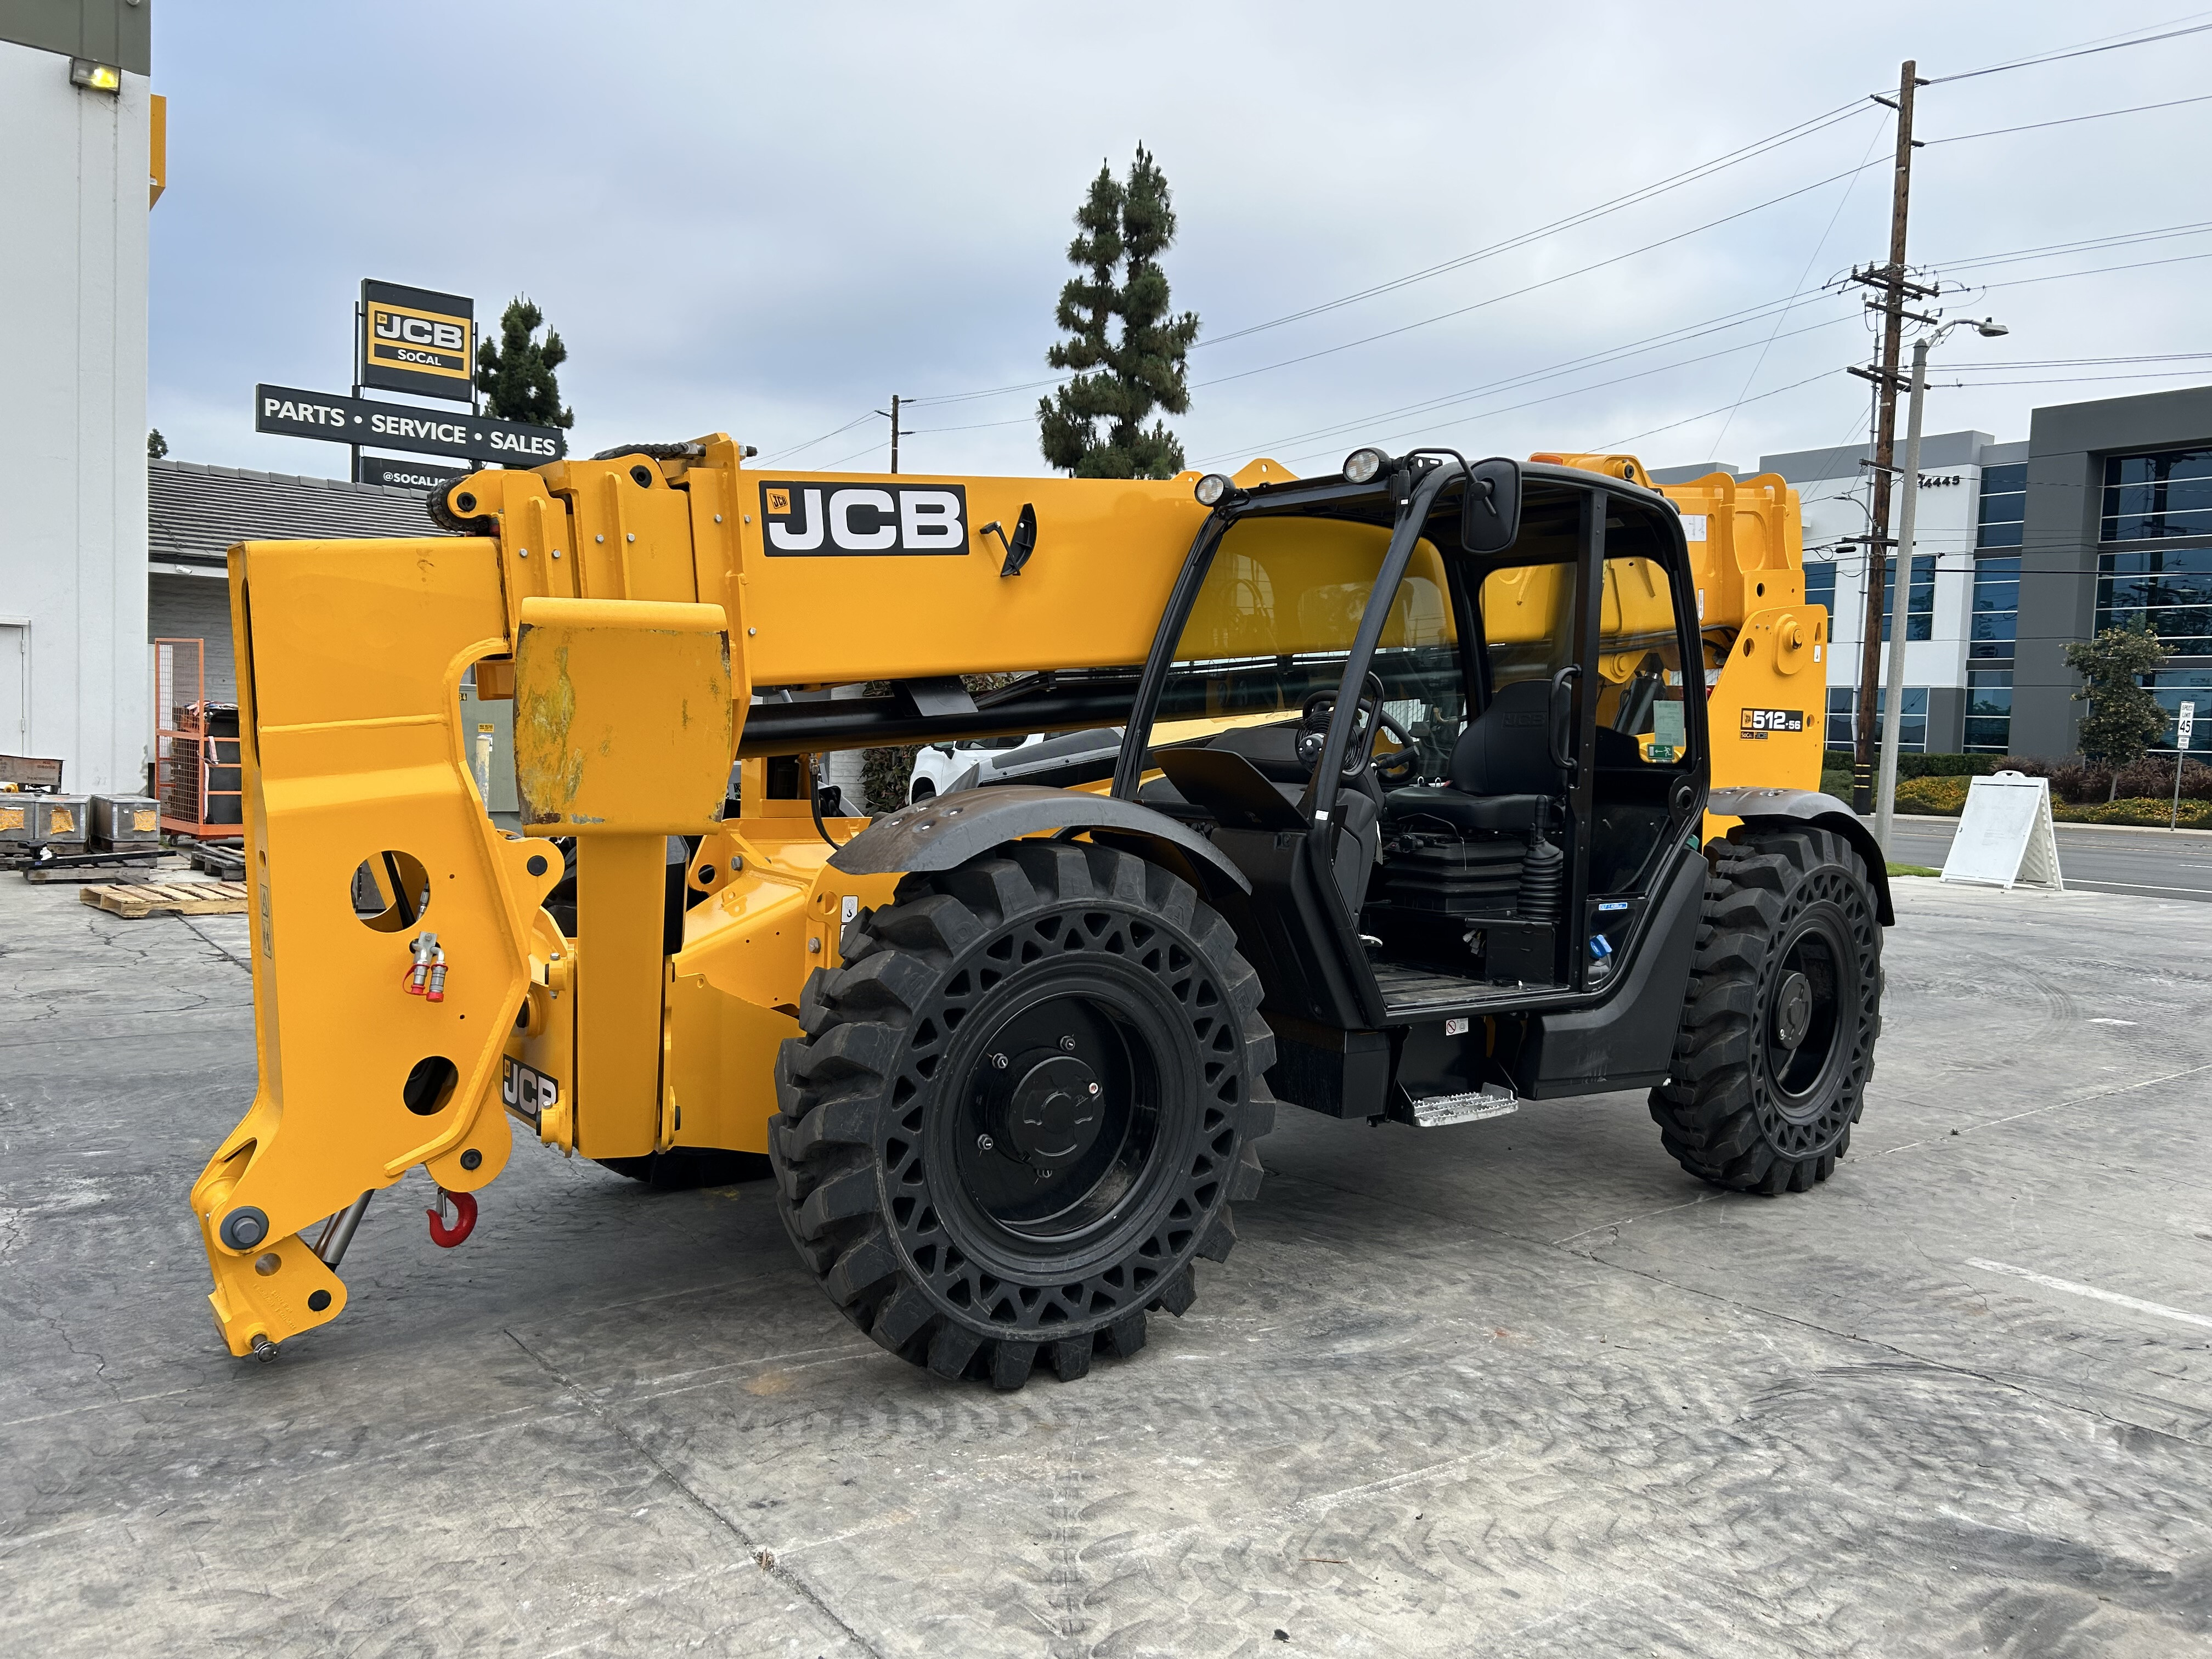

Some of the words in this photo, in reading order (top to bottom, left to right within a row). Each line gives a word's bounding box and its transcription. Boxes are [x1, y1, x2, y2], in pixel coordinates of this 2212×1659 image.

[377, 315, 462, 349] JCB
[265, 398, 345, 427] PARTS
[371, 414, 466, 443] SERVICE
[490, 431, 556, 456] SALES
[772, 495, 787, 507] JCB
[769, 489, 964, 550] JCB
[2180, 720, 2191, 732] 45
